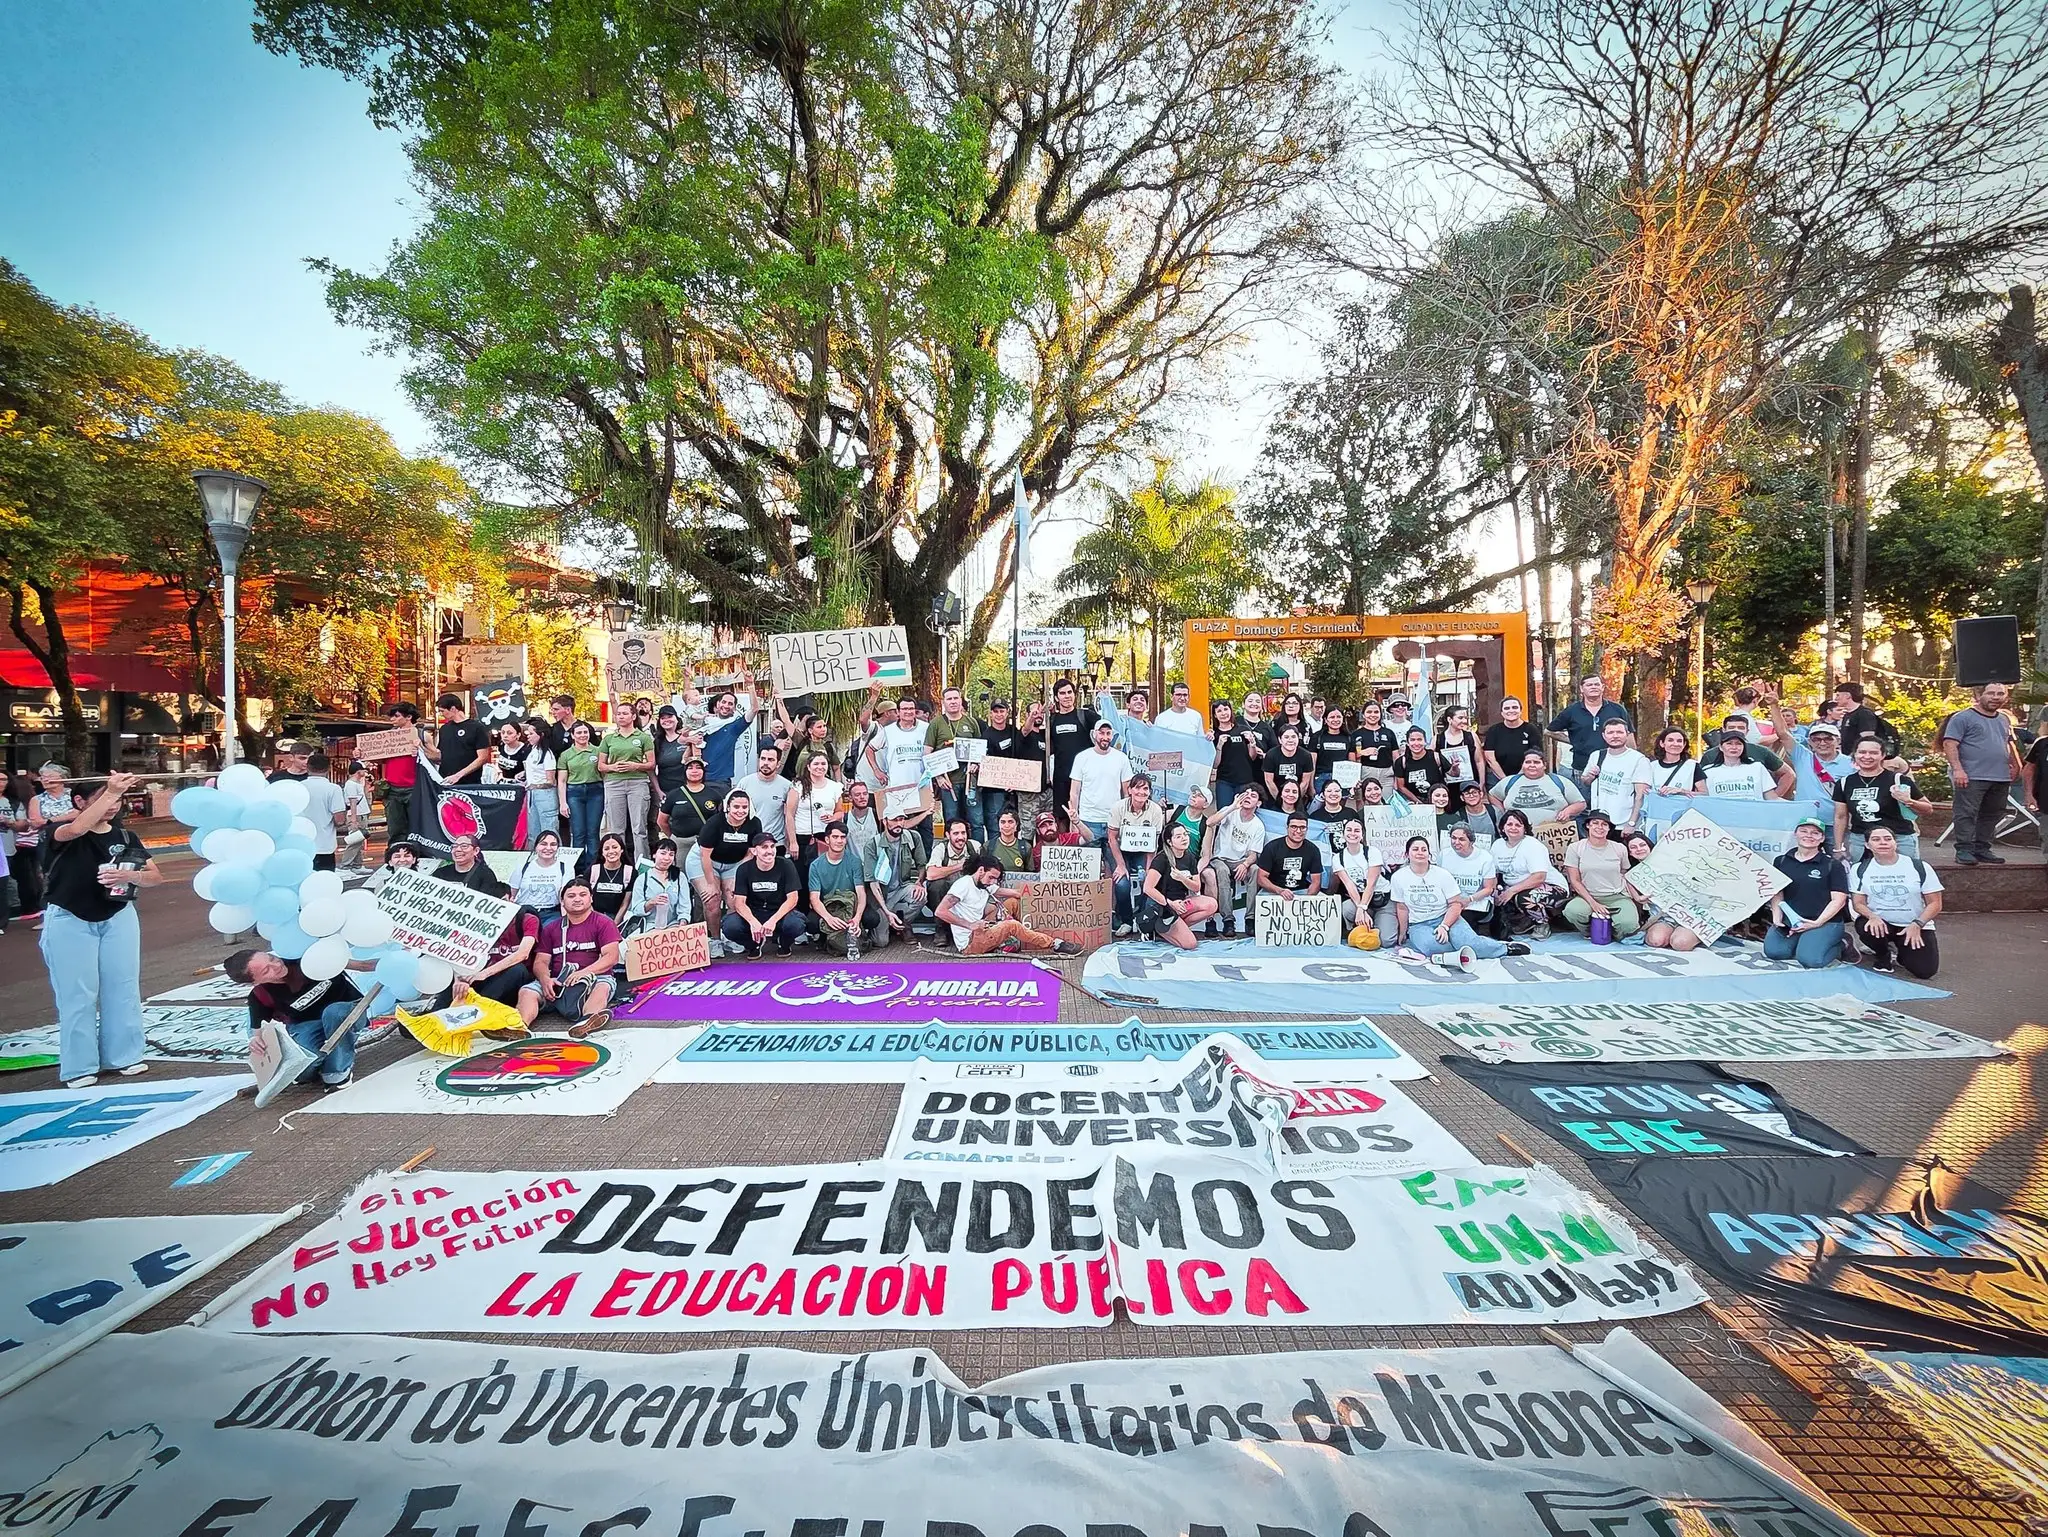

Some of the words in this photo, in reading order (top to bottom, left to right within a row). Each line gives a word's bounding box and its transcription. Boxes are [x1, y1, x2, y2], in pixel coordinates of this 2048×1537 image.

[1192, 623, 1228, 632] PLAZA
[1234, 625, 1285, 637] Domingo
[1290, 626, 1300, 634] F.
[1402, 623, 1434, 631] CIUDAD
[1436, 623, 1448, 631] DE
[1451, 622, 1499, 631] ELDORADO
[772, 629, 903, 661] PALESTINA
[1046, 638, 1054, 646] de
[1018, 648, 1027, 658] NO
[1046, 647, 1075, 655] PUEBLOS
[1028, 659, 1036, 667] de
[781, 656, 863, 691] LIBRE
[1048, 848, 1083, 860] EDUCAR
[1717, 836, 1753, 865] ESTA
[1042, 862, 1089, 872] COMBATIR
[390, 871, 413, 887] NO
[408, 877, 438, 895] HAY
[434, 886, 475, 908] NADA
[475, 898, 506, 920] QUE
[1022, 883, 1092, 897] ASAMBLEA
[1097, 882, 1105, 894] DE
[378, 886, 407, 905] NOS
[404, 894, 443, 918] HAGA
[440, 907, 471, 927] MAS
[465, 917, 501, 938] LIBRES
[1022, 898, 1093, 913] ESTUDIANTES
[1260, 898, 1285, 917] SIN
[392, 908, 409, 924] LA
[1022, 911, 1110, 930] GUARDAPARQUES
[1269, 916, 1291, 932] NO
[687, 939, 703, 952] LA
[1265, 931, 1325, 947] FUTURO
[411, 936, 431, 949] DE
[428, 941, 478, 966] CALIDAD
[909, 980, 1039, 996] MORADA
[696, 1034, 844, 1053] DEFENDAMOS
[847, 1034, 875, 1052] LA
[881, 1028, 1002, 1053] EDUCACIÓN
[1011, 1027, 1111, 1056] PÚBLICA,
[1248, 1032, 1279, 1050] DE
[1281, 1030, 1380, 1050] CALIDAD
[1558, 1118, 1729, 1154] EAE
[540, 1156, 1356, 1257] DEFENDEMOS
[293, 1178, 582, 1272] Educación
[252, 1282, 329, 1328] No
[352, 1251, 436, 1289] Hay
[443, 1206, 576, 1259] Futuro
[485, 1270, 580, 1318] LA
[590, 1256, 947, 1318] EDUCACIÓN
[410, 1360, 515, 1444] de
[498, 1353, 806, 1450] Docentes
